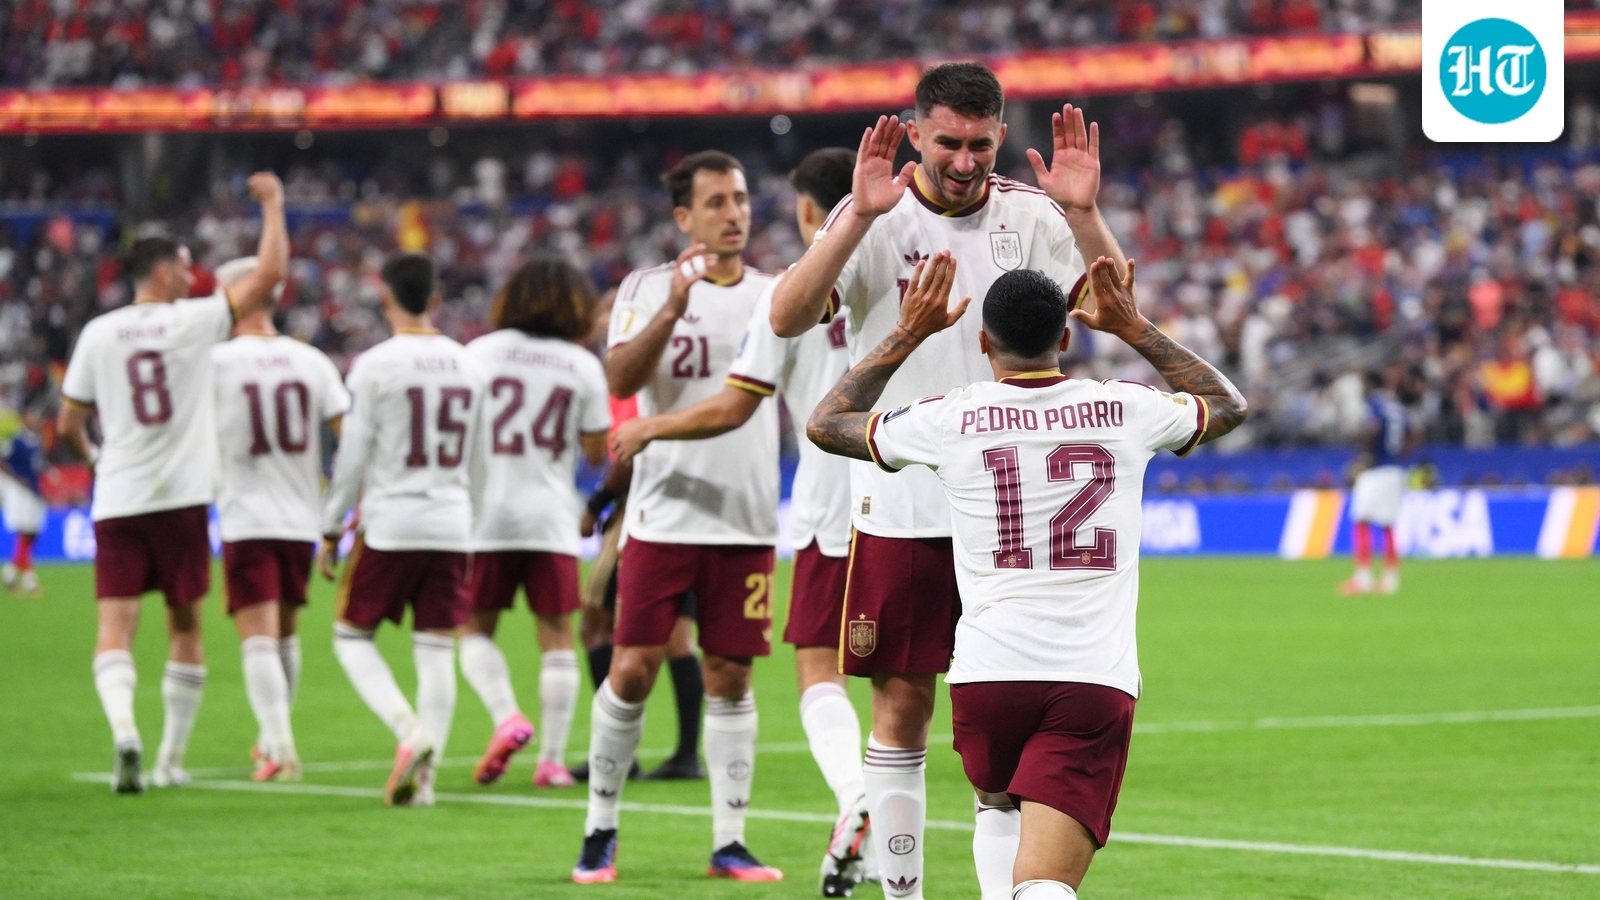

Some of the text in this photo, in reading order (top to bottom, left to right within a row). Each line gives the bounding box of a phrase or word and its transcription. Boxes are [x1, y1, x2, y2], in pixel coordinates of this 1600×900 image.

[126, 349, 174, 427] 8
[672, 335, 710, 378] 21
[242, 380, 309, 455] 10
[404, 385, 473, 469] 15
[491, 376, 574, 462] 24
[960, 400, 1124, 434] PEDRO PORRO
[982, 443, 1117, 571] 12
